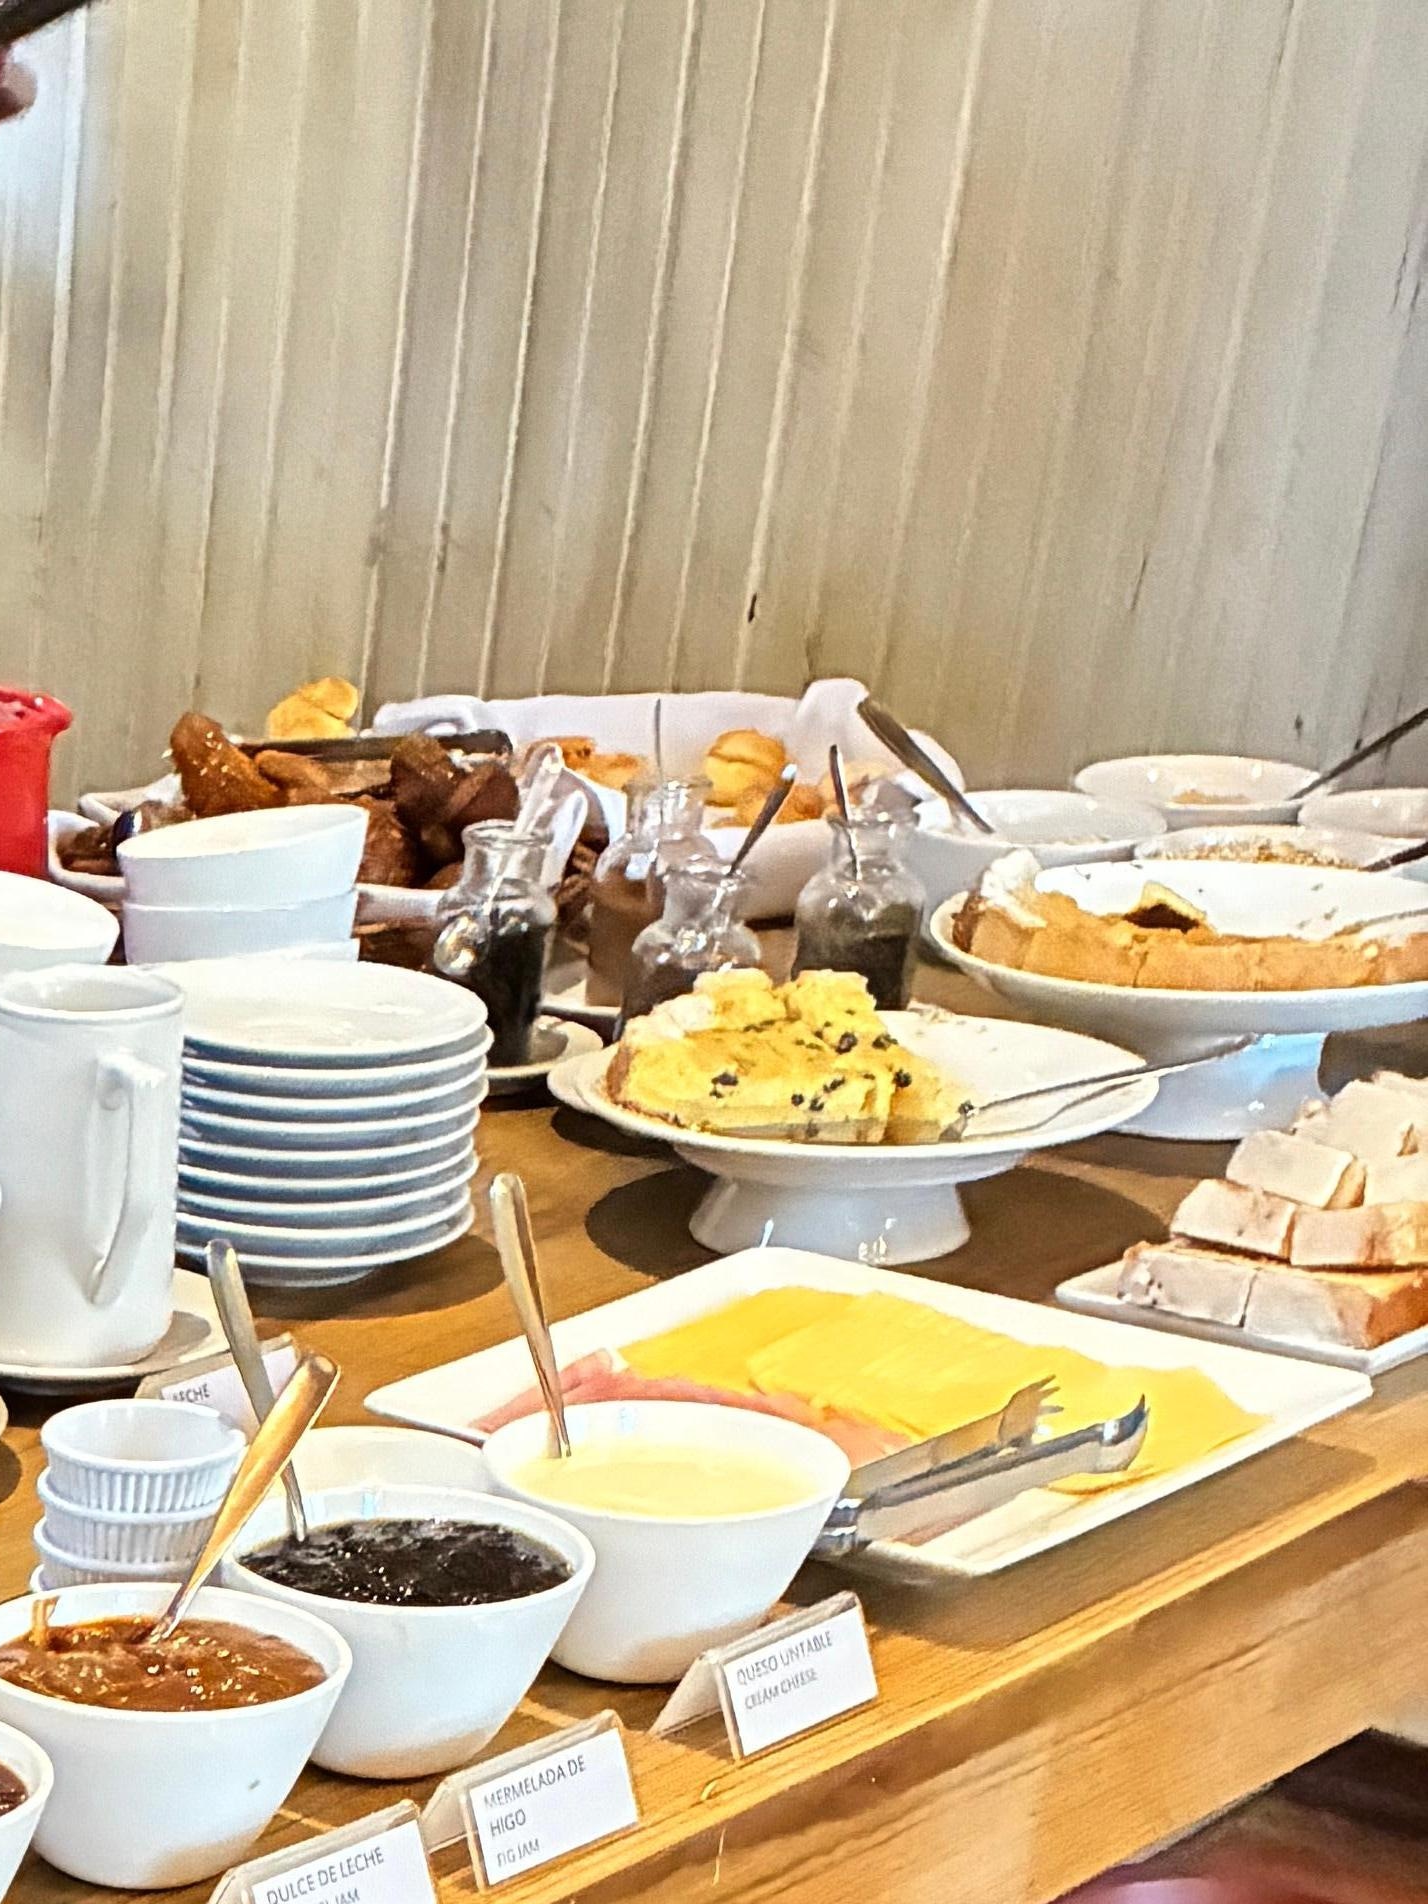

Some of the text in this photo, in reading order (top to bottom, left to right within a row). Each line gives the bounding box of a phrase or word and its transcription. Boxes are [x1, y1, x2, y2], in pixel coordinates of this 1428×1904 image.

[484, 1755, 586, 1808] MERMELADA DE
[489, 1809, 527, 1838] HIGO
[317, 1866, 339, 1886] DE
[339, 1846, 385, 1879] LECHE
